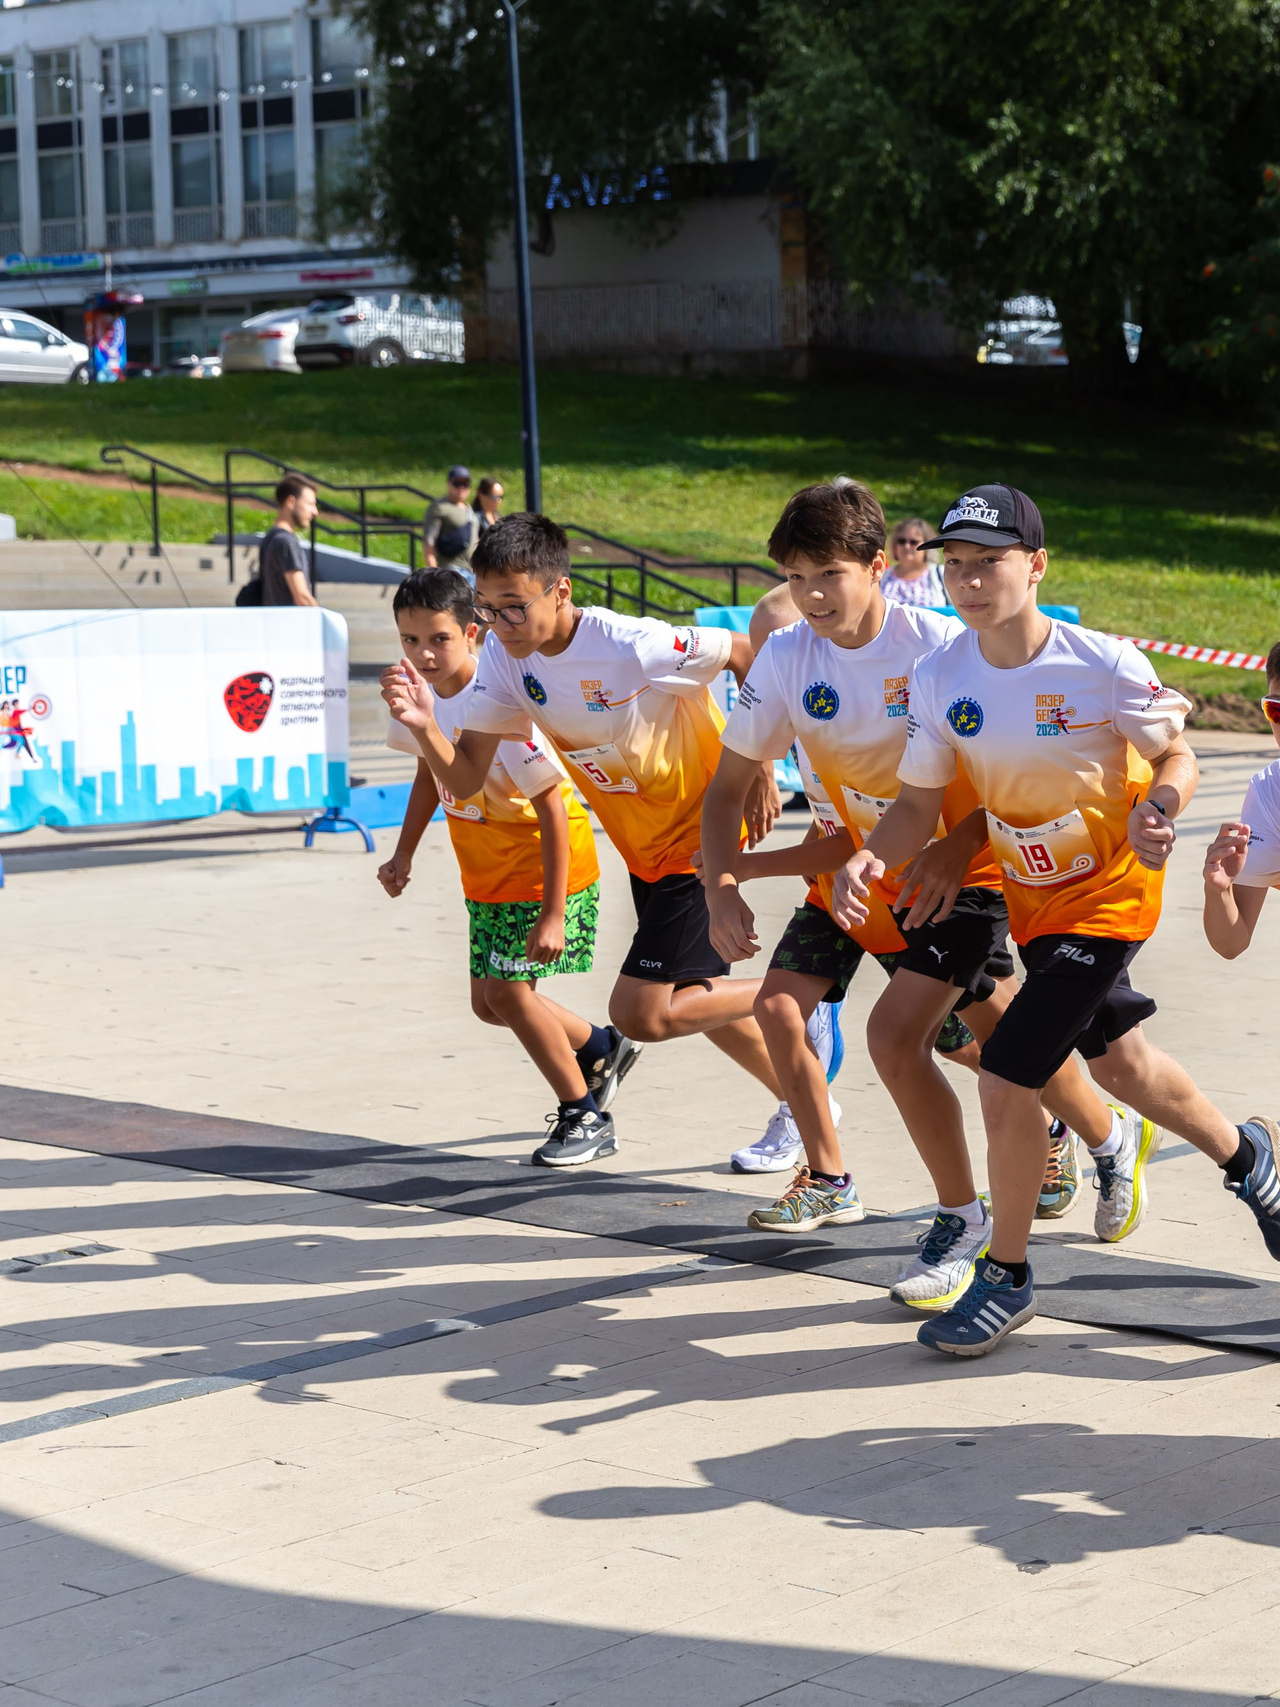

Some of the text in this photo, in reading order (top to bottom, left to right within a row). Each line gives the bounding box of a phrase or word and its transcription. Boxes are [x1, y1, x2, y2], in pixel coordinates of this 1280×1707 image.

[580, 680, 602, 691] ЛАЗЕР
[884, 676, 908, 691] ЛАЗЕР
[1035, 694, 1065, 707] ЛАЗЕР
[887, 704, 907, 717] 2025
[1036, 723, 1060, 737] 2025
[1018, 844, 1054, 873] 19
[1053, 943, 1095, 965] FILA
[639, 958, 662, 969] CLVR
